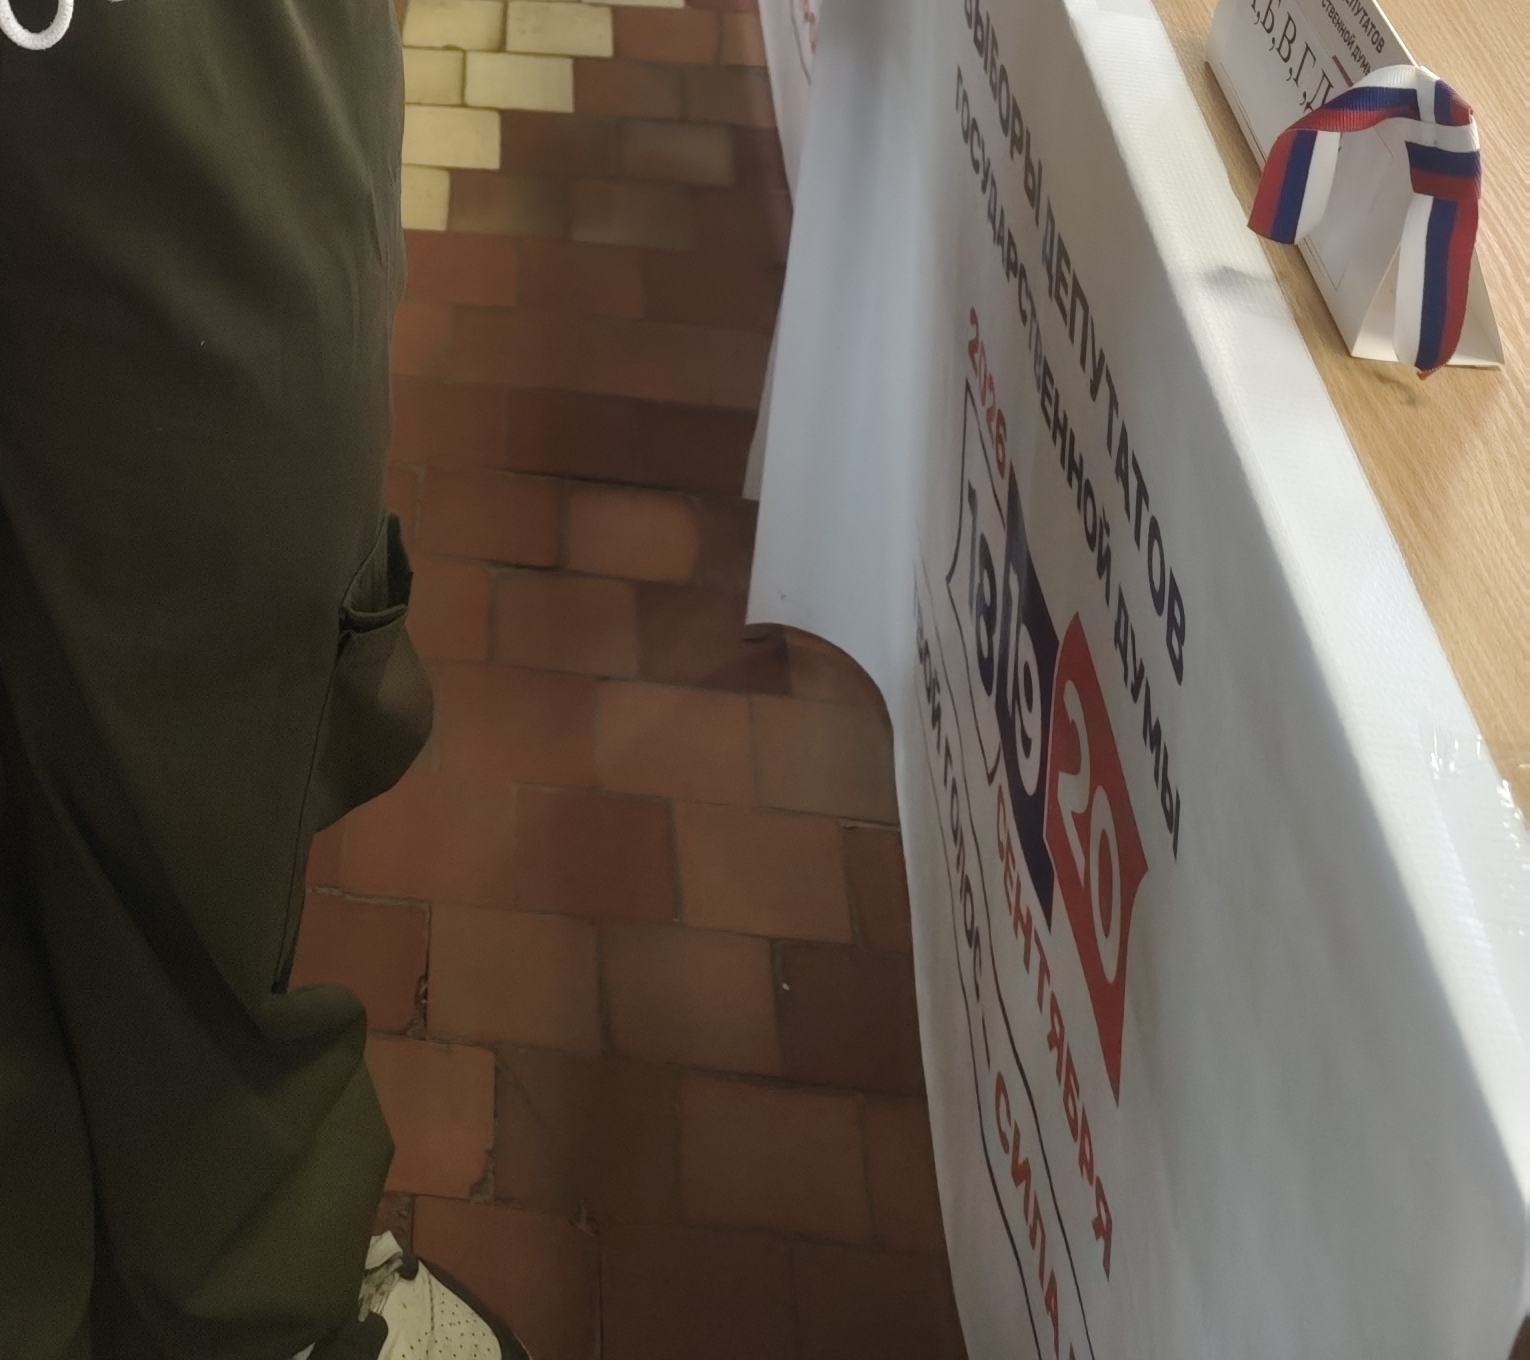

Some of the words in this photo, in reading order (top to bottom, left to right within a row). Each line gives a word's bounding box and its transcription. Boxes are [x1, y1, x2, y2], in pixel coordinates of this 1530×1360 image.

[955, 63, 1112, 607] ГОСУДАРСТВЕННОЙ
[1113, 583, 1183, 863] ДУМЫ
[969, 305, 1008, 480] 2026
[1042, 194, 1186, 687] ДЕПУТАТОВ
[968, 481, 997, 697] 18
[1006, 560, 1042, 798] 19
[1057, 679, 1121, 985] 20
[997, 783, 1113, 1282] СЕНТЯБРЯ
